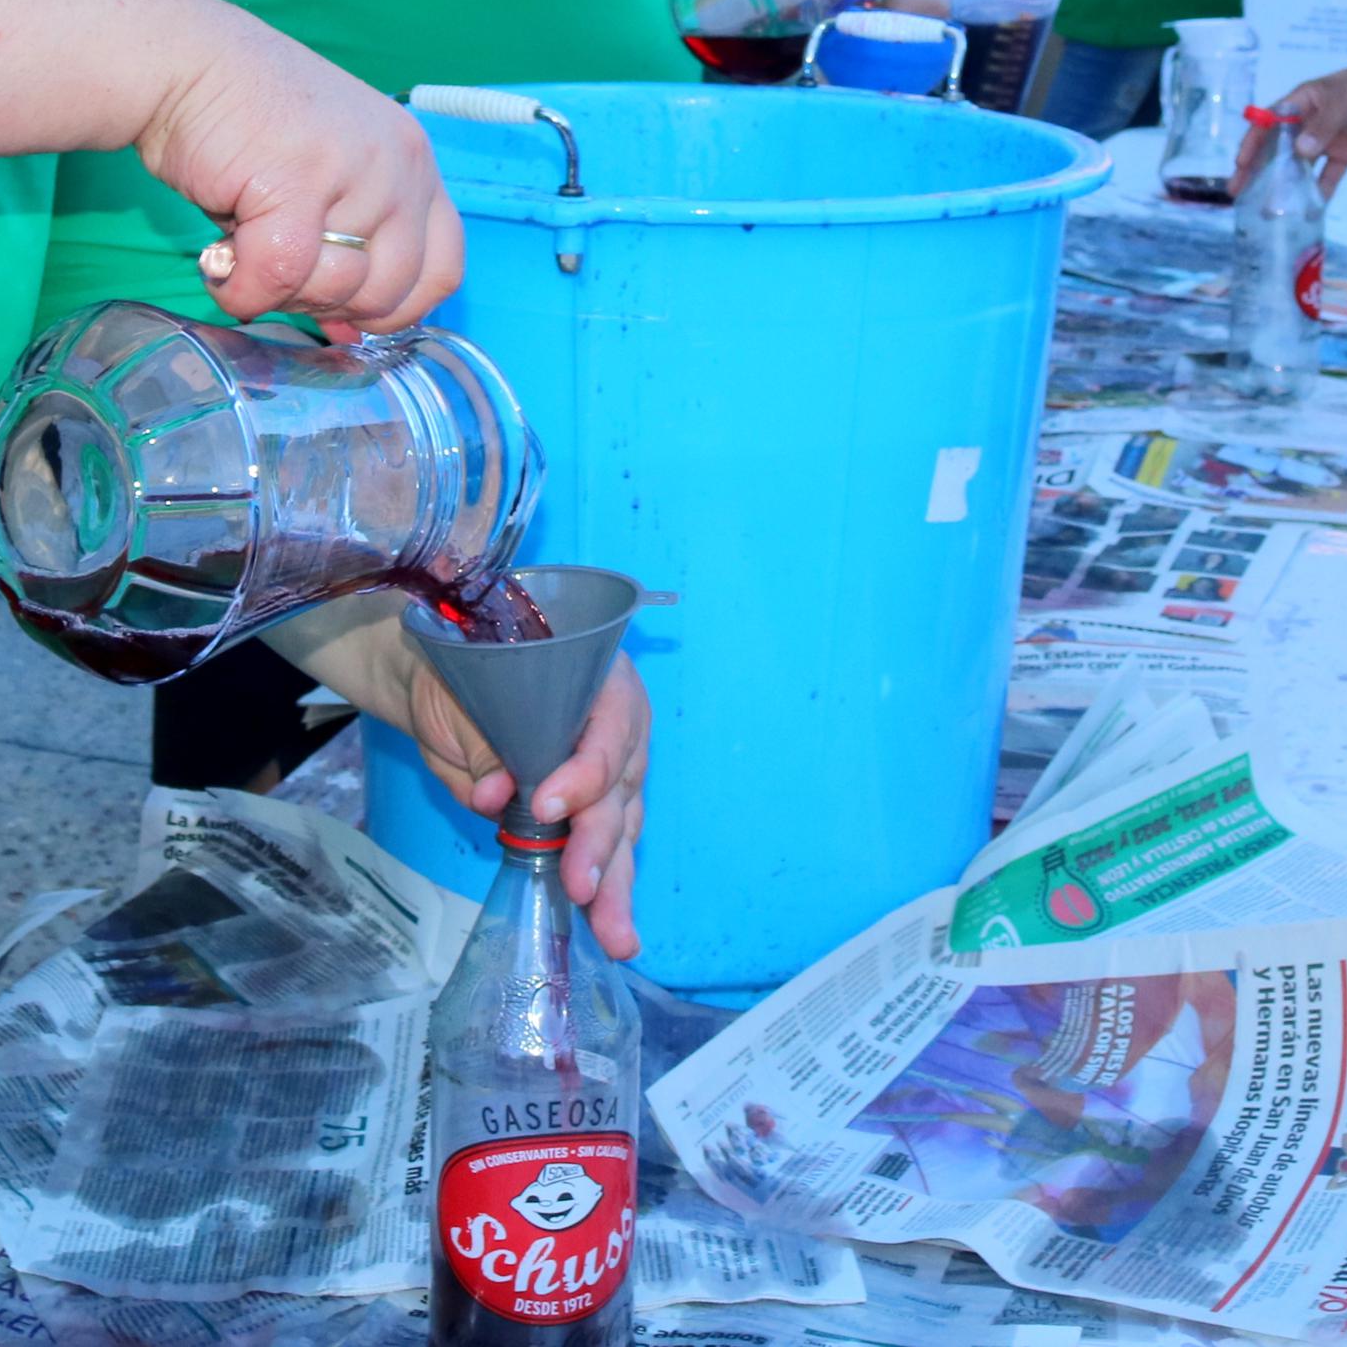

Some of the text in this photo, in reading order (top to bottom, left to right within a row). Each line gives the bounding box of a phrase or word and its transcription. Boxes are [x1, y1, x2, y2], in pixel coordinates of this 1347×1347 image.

[165, 810, 188, 828] La
[1103, 842, 1215, 903] ADMINISTRATIVO
[1133, 827, 1290, 907] CURSO PRESENCIAL
[1118, 983, 1137, 998] A
[1305, 962, 1325, 1003] Las
[1091, 983, 1118, 1055] TAYLOR
[1115, 1000, 1136, 1036] LOS
[1104, 1037, 1132, 1072] PIES
[1301, 1008, 1323, 1094] nuevas
[1072, 1055, 1106, 1086] SWIFT
[1192, 966, 1276, 1197] y Hermanas Hospitalarias
[1211, 964, 1301, 1216] pararán en San Juan de Dios
[319, 1116, 368, 1151] 75
[481, 1096, 619, 1135] GASEOSA
[1282, 1097, 1320, 1151] líneas
[467, 1157, 486, 1174] SIN
[485, 1146, 569, 1168] CONSERVANTES
[576, 1145, 596, 1158] SIN
[1270, 1152, 1298, 1172] de
[404, 1165, 430, 1196] más
[1236, 1171, 1284, 1230] autobús
[513, 1292, 594, 1317] DESDE 1972
